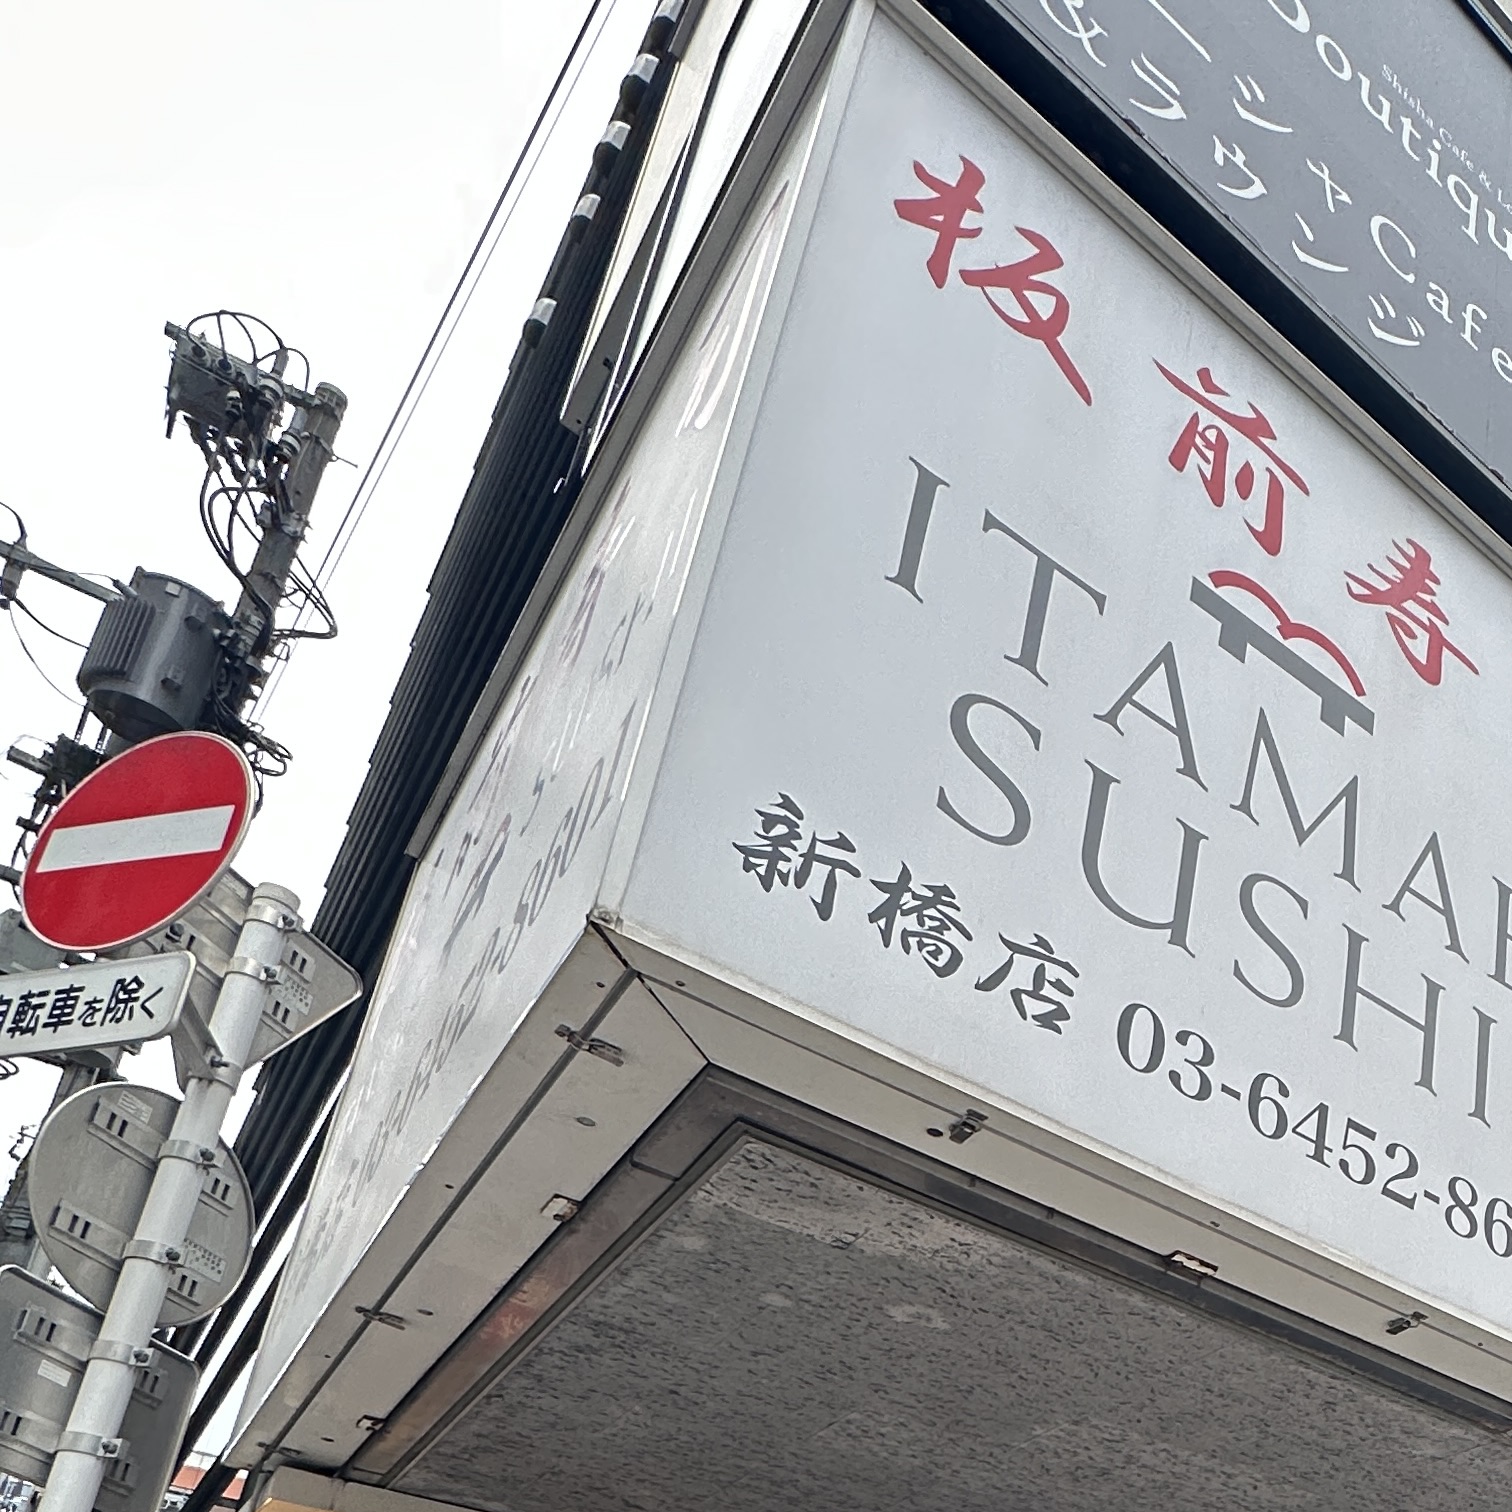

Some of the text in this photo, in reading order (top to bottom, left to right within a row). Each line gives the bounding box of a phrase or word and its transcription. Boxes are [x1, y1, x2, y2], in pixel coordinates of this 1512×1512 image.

[1381, 63, 1437, 127] Shisha
[1438, 127, 1475, 170] Cafe
[1478, 171, 1494, 190] &
[733, 794, 1081, 1036] 新橋店
[937, 693, 1496, 1126] SUSHI
